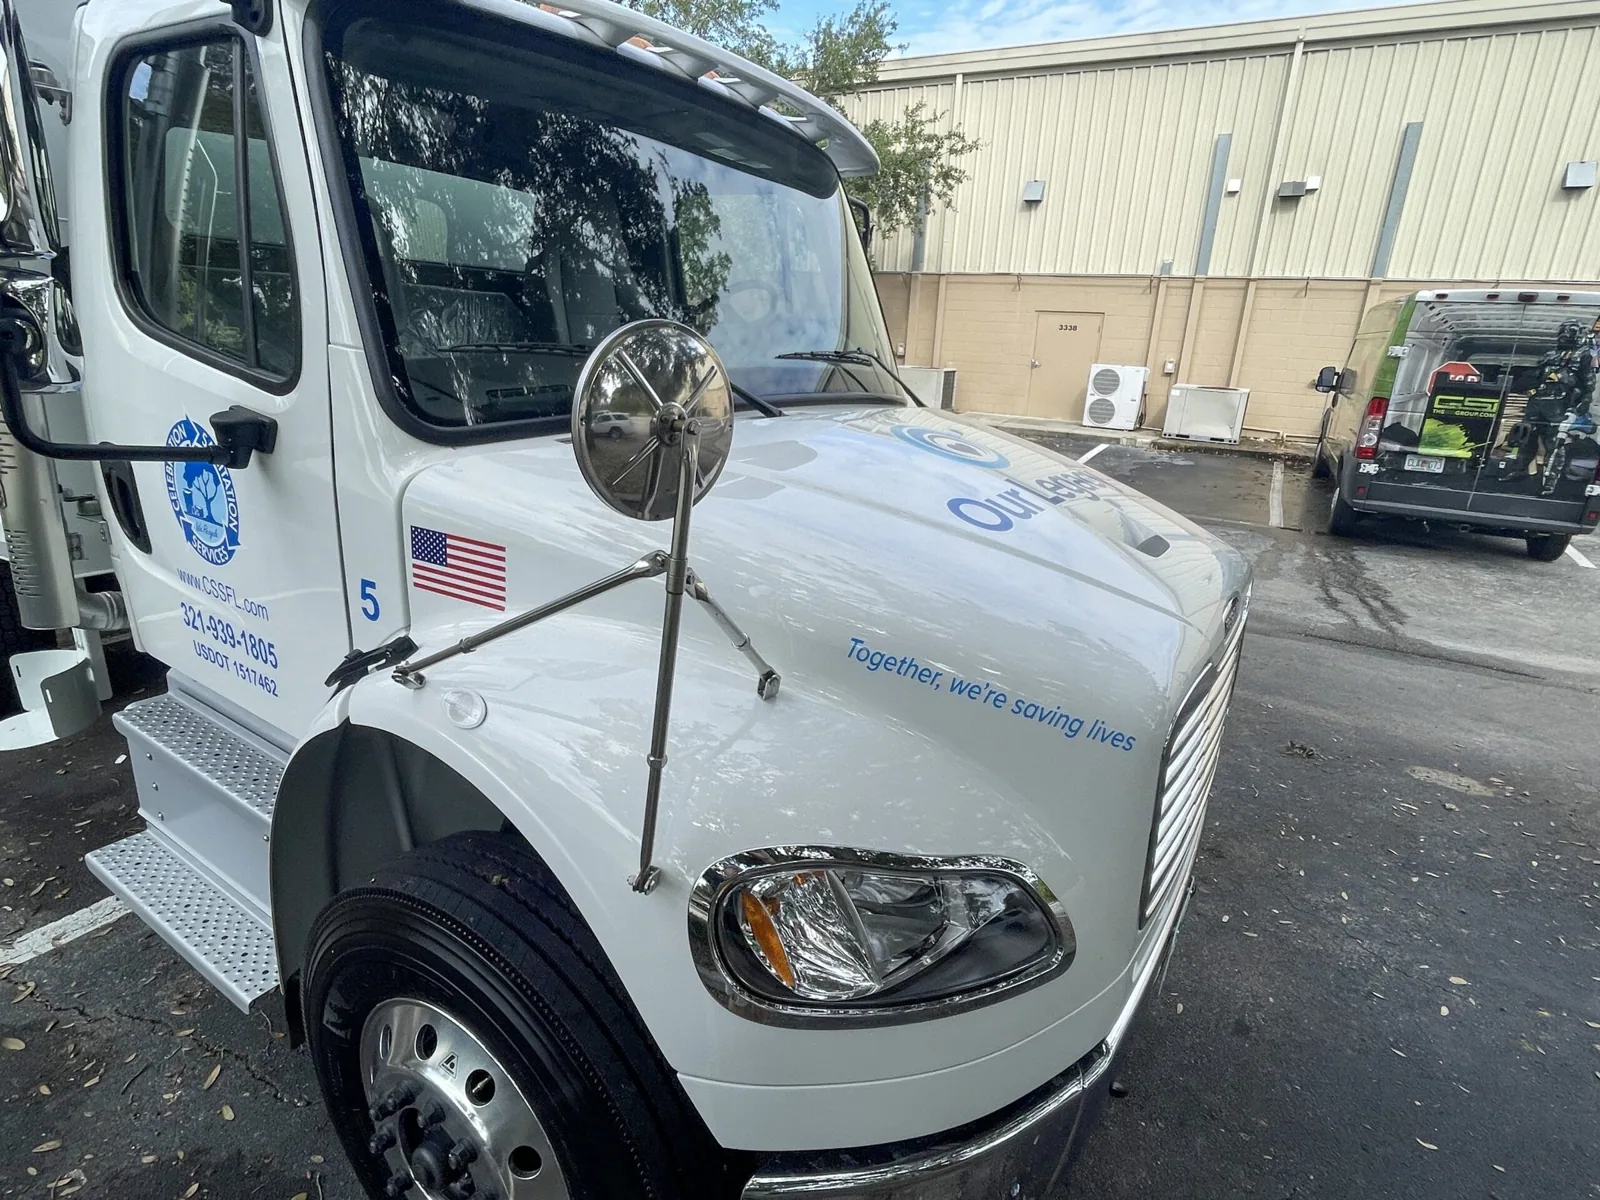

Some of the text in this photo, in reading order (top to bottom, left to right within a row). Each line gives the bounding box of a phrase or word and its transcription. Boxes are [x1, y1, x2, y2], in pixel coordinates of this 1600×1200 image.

[1058, 324, 1078, 332] 3338
[166, 424, 187, 511] CELEBTION
[192, 535, 229, 564] SERVICES
[177, 568, 269, 621] www.CSSFL.com
[360, 578, 380, 622] 5
[180, 602, 279, 669] 321-939-1805
[193, 639, 279, 697] USDOT 1517462
[847, 637, 1136, 752] Together, we're saving lives
